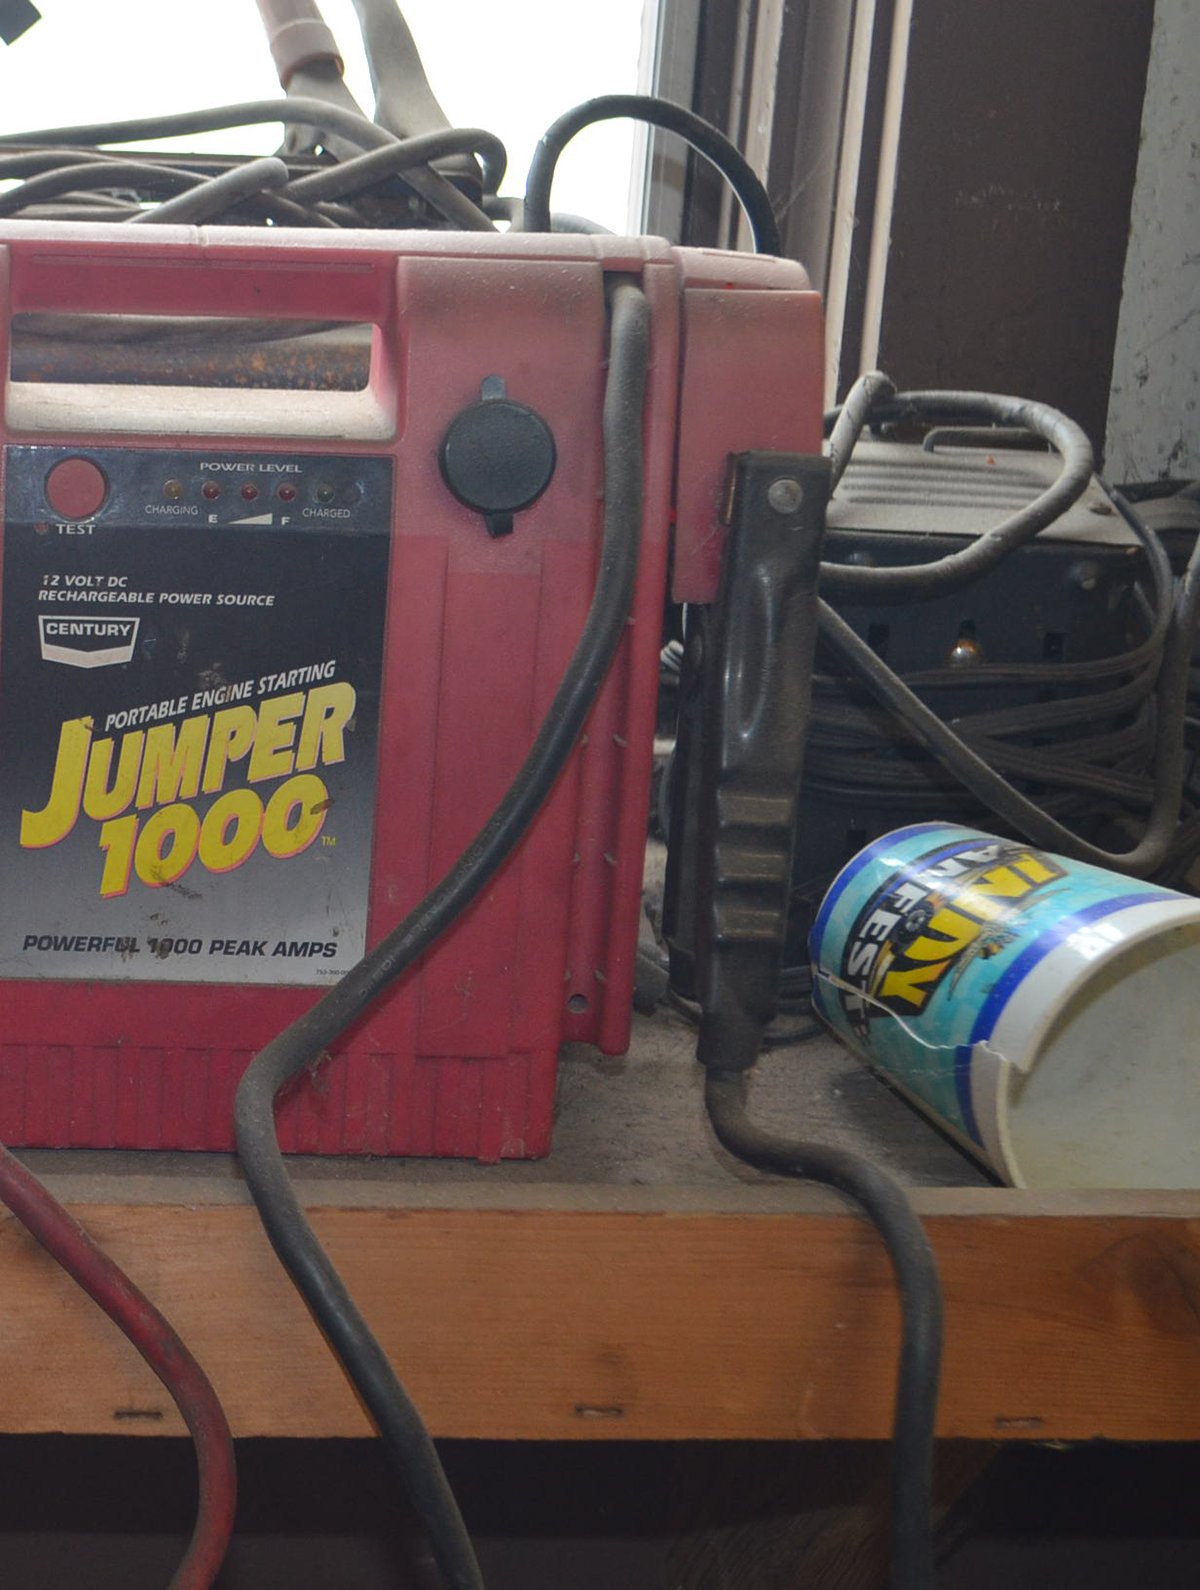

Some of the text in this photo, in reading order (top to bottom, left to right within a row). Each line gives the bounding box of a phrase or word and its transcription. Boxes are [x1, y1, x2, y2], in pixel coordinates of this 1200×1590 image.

[200, 462, 303, 474] POWER LEVEL
[144, 504, 199, 516] CHARGING
[302, 507, 351, 519] CHARGED
[208, 513, 219, 524] E
[280, 516, 291, 526] F
[55, 523, 97, 535] TEST
[42, 574, 129, 588] 12 VOLT DC
[37, 589, 276, 607] RECHARGEABLE POWER SOURCE
[45, 621, 132, 637] CENTURY
[104, 660, 337, 732] PORTABLE ENGINE STARTING
[19, 681, 357, 849] JUMPER
[99, 773, 330, 900] 1000
[22, 934, 338, 958] POWERFUL 1000 PEAK AMPS
